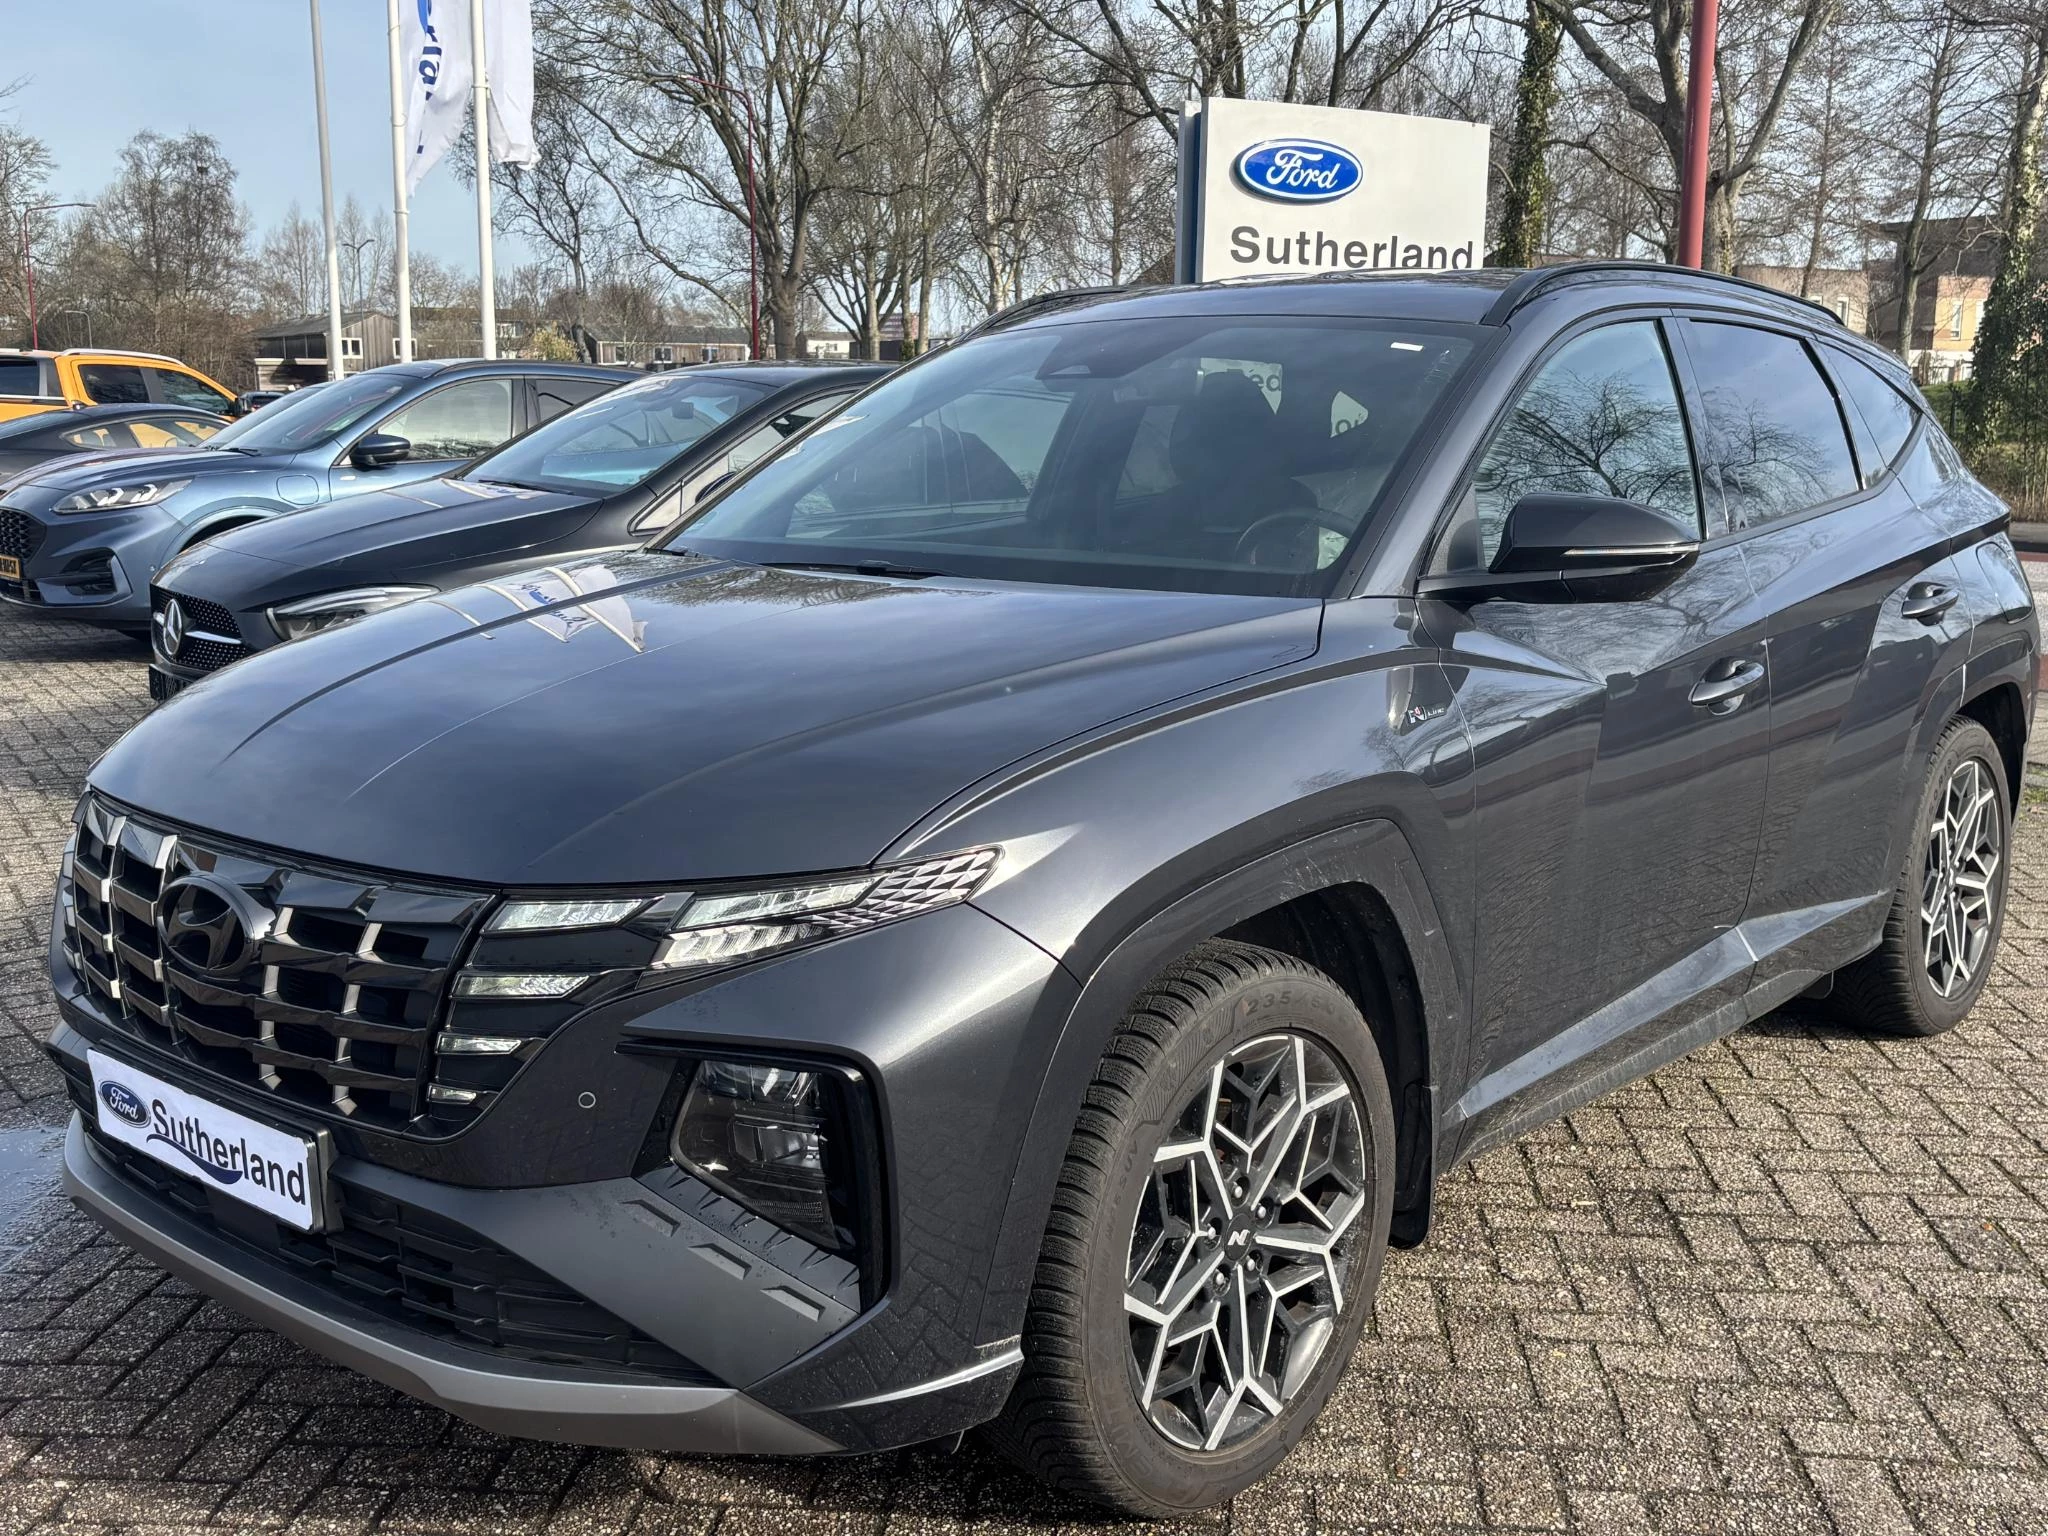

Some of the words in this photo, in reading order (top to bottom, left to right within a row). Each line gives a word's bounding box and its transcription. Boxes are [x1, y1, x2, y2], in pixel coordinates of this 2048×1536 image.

[1266, 149, 1341, 188] Ford
[1230, 226, 1473, 269] Sutherland
[109, 1086, 138, 1120] Ford
[151, 1098, 306, 1205] Sutherland
